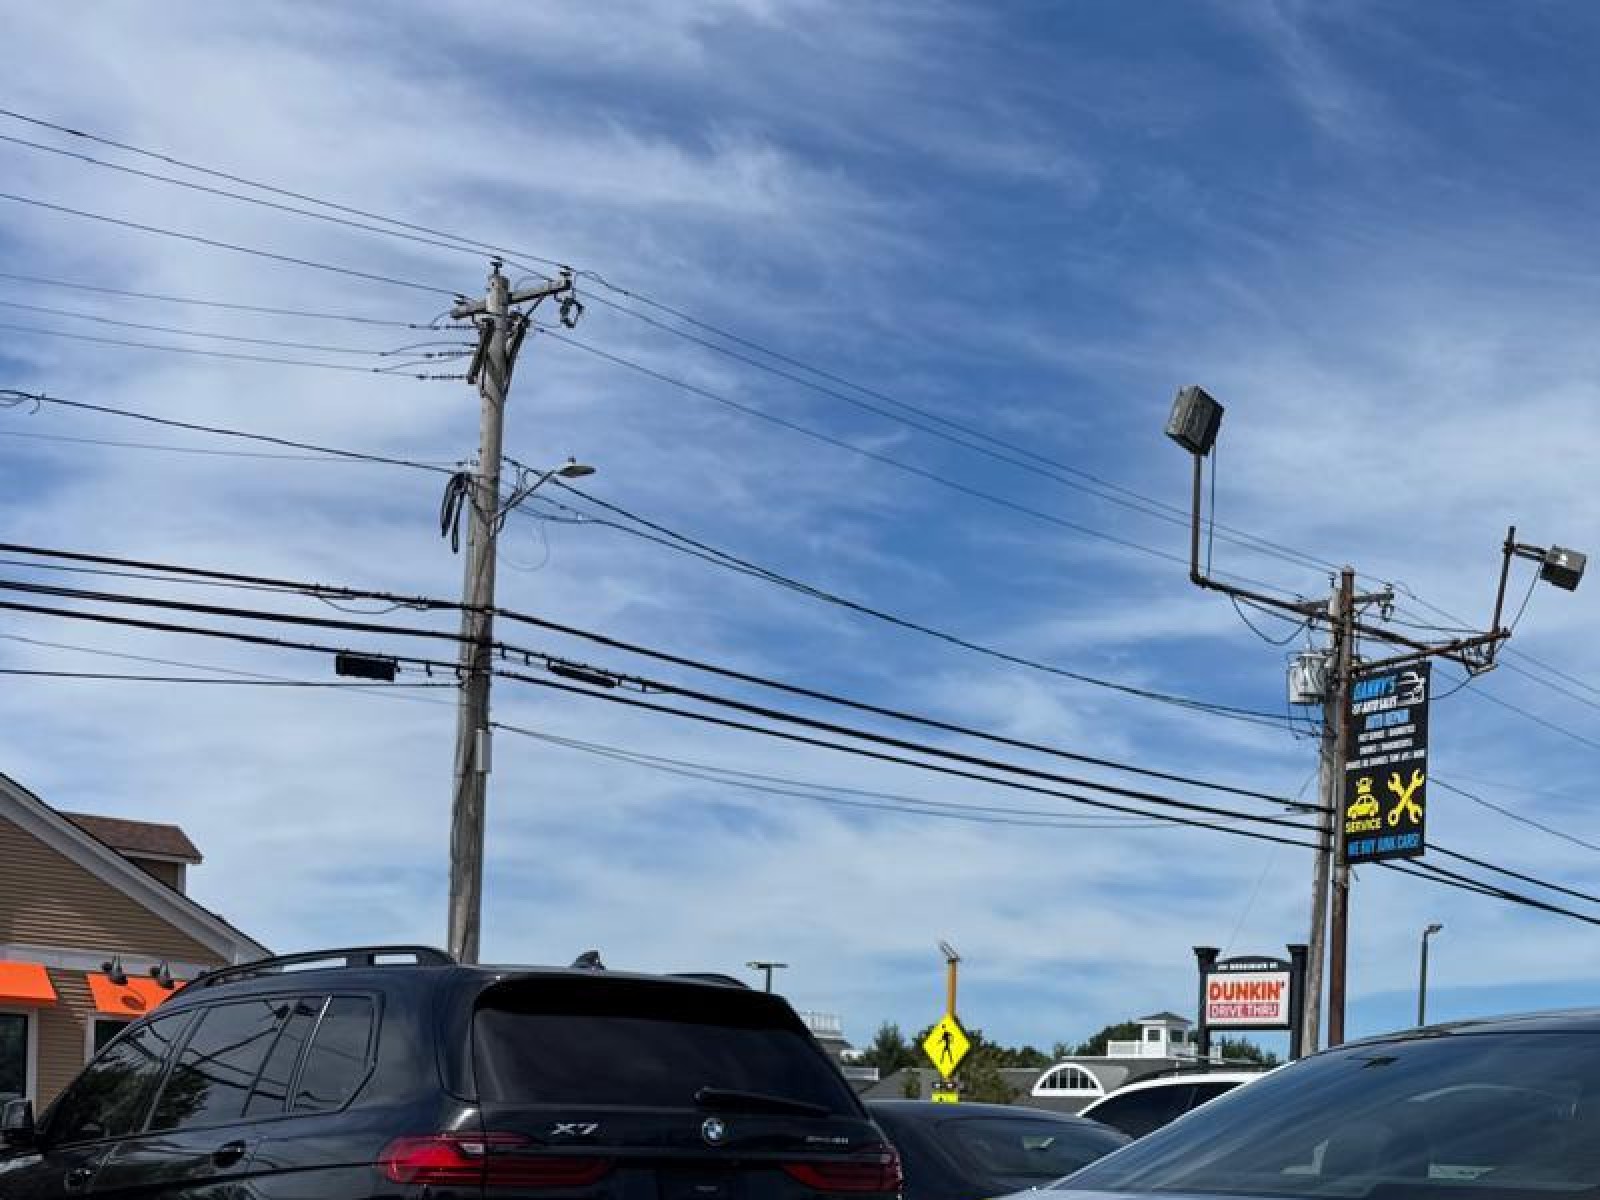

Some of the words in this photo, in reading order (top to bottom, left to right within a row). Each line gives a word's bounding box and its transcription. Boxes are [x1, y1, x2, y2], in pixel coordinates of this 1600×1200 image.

[1209, 980, 1284, 1001] DUNKIN'
[1211, 1005, 1242, 1017] DRIVE
[1247, 1004, 1278, 1016] THRU
[552, 1123, 598, 1135] X7
